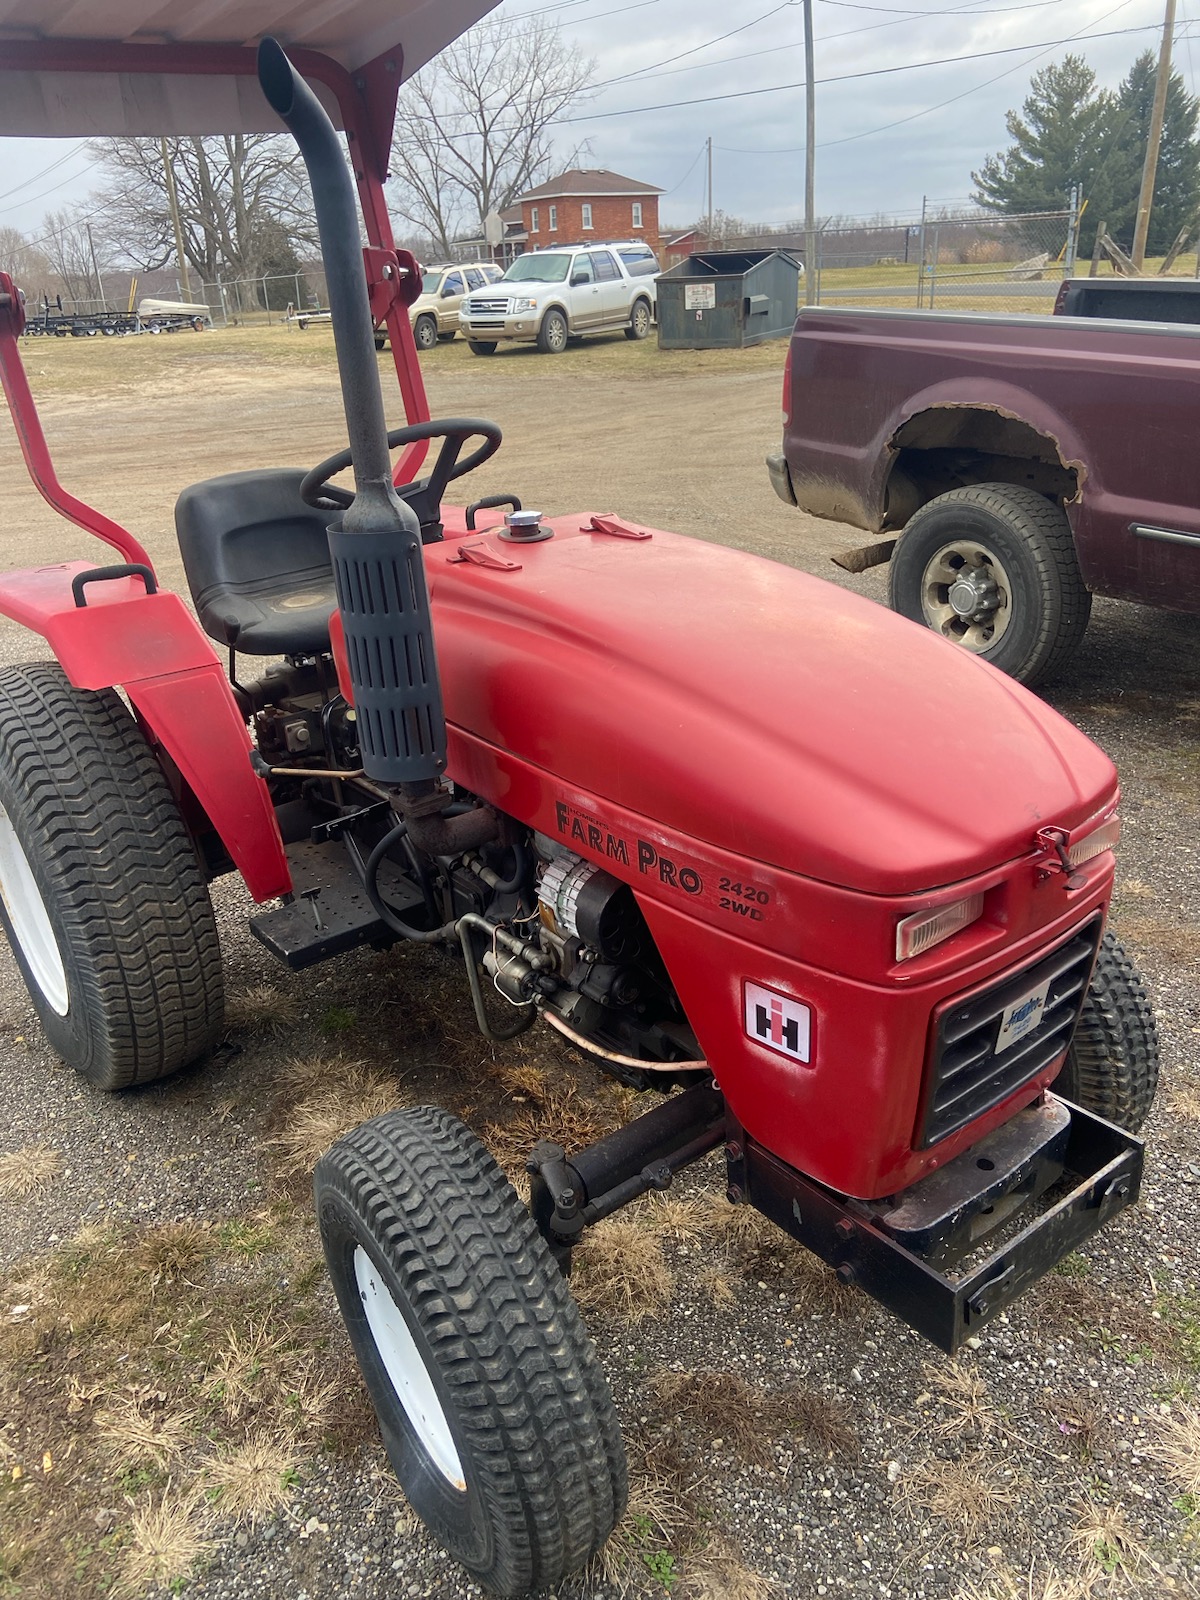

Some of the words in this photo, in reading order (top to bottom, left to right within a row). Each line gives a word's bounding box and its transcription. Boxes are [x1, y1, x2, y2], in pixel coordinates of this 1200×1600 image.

[555, 801, 630, 866] FARM
[638, 839, 703, 896] PRO
[719, 877, 769, 905] 2420
[719, 897, 764, 921] 2WD
